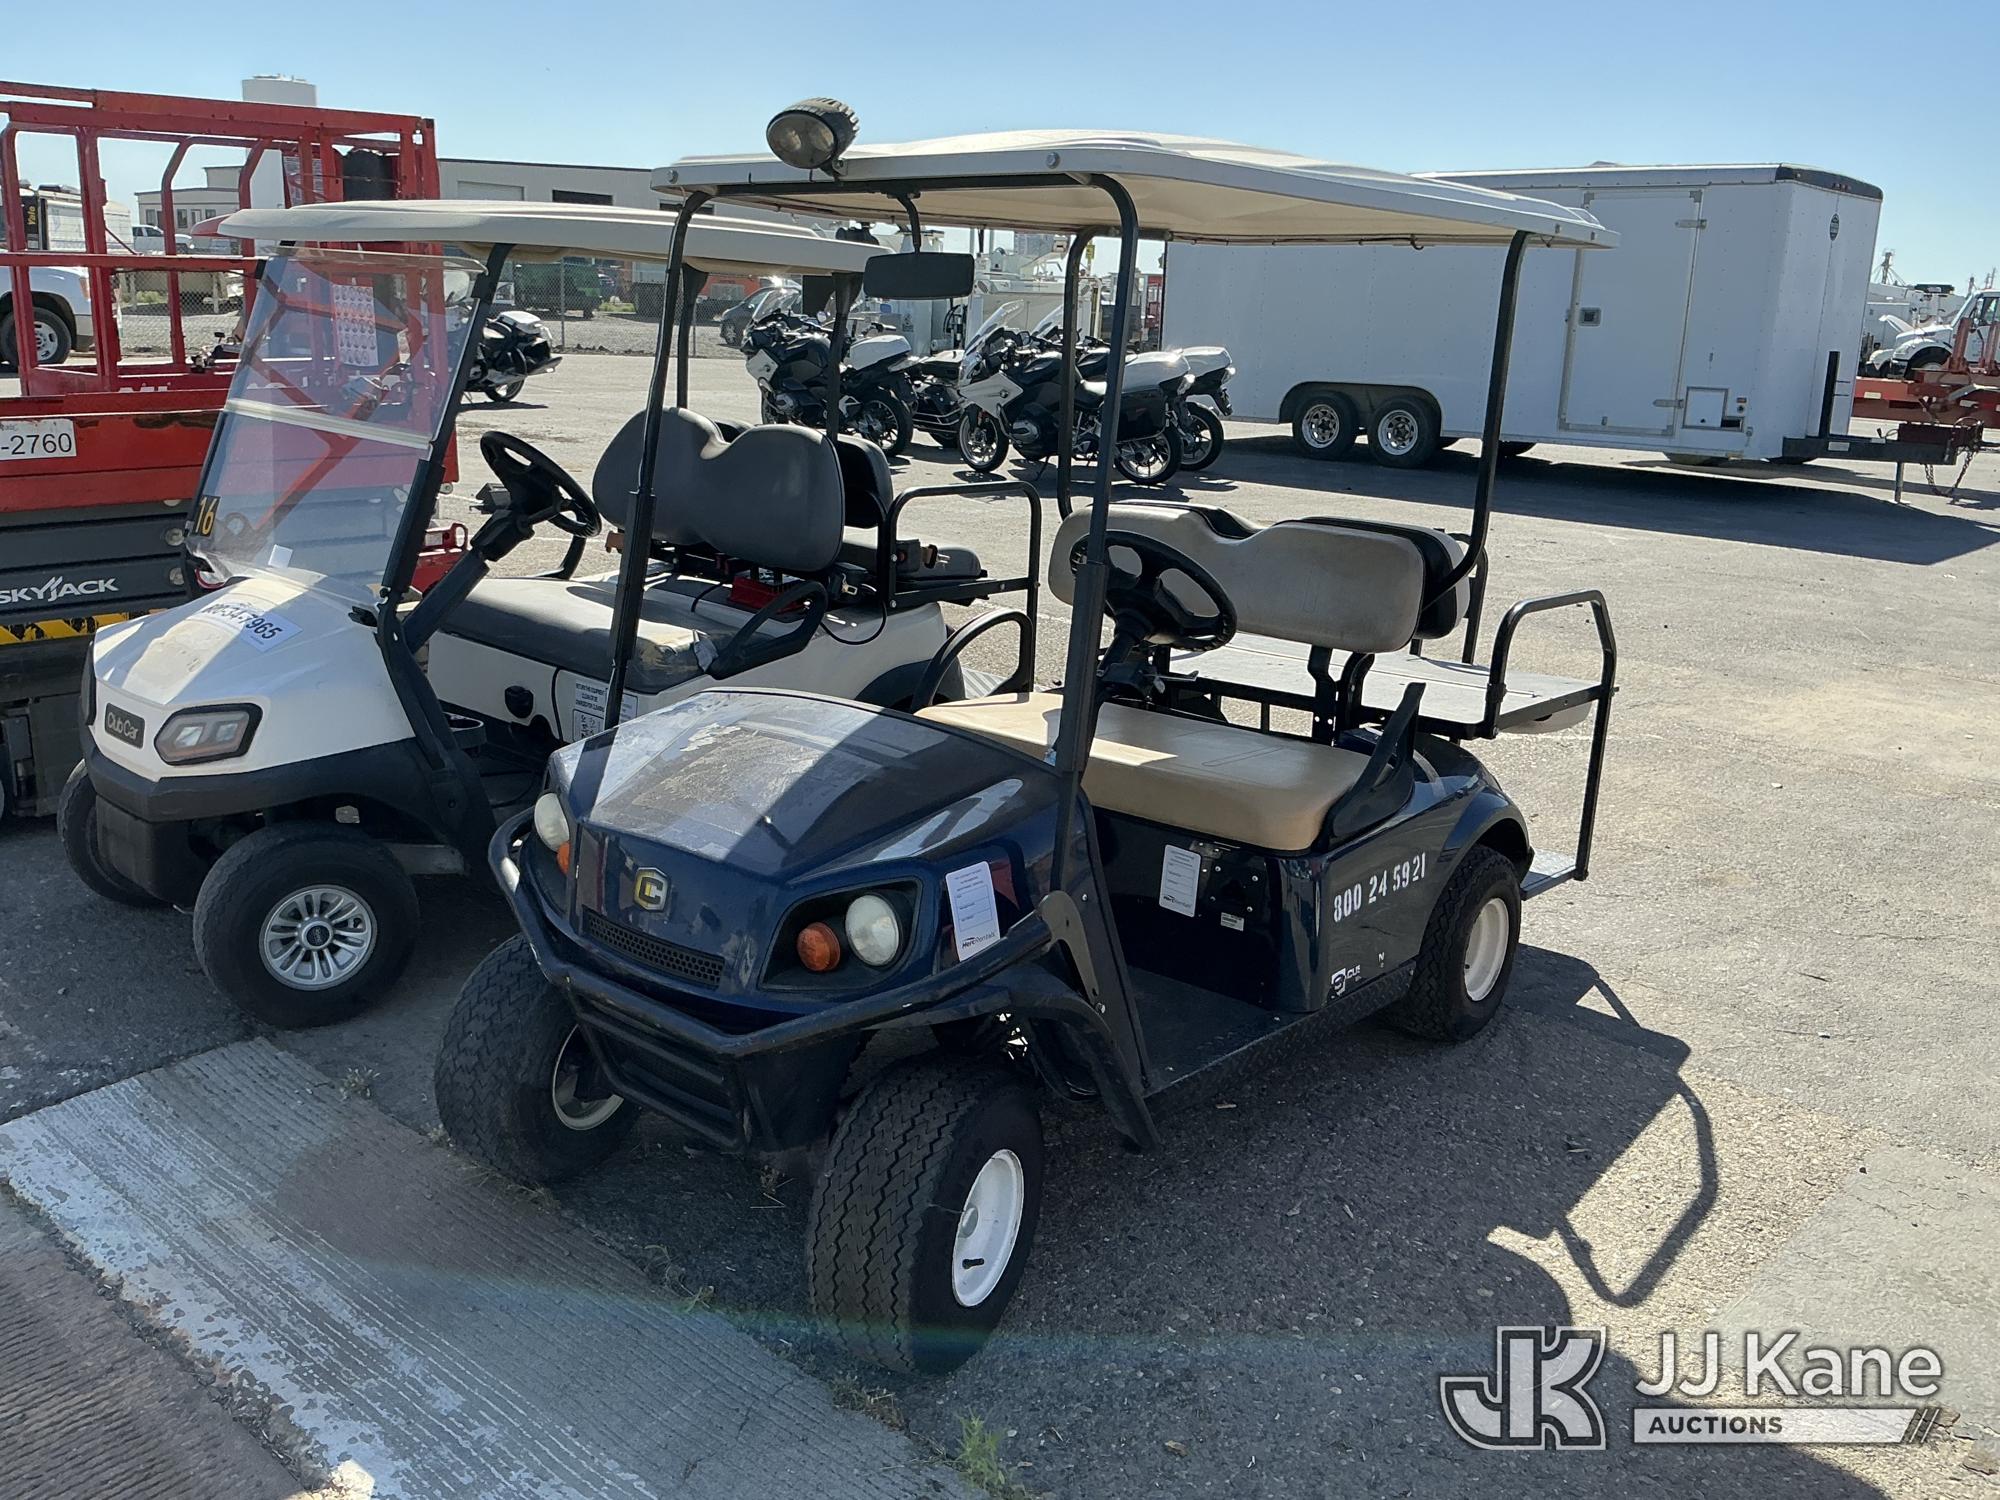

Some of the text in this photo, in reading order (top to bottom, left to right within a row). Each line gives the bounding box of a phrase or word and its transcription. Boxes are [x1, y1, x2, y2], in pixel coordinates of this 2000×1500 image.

[196, 497, 217, 535] 16
[0, 576, 119, 604] SKYJACK
[1333, 883, 1362, 923] 800
[1368, 869, 1387, 904] 24
